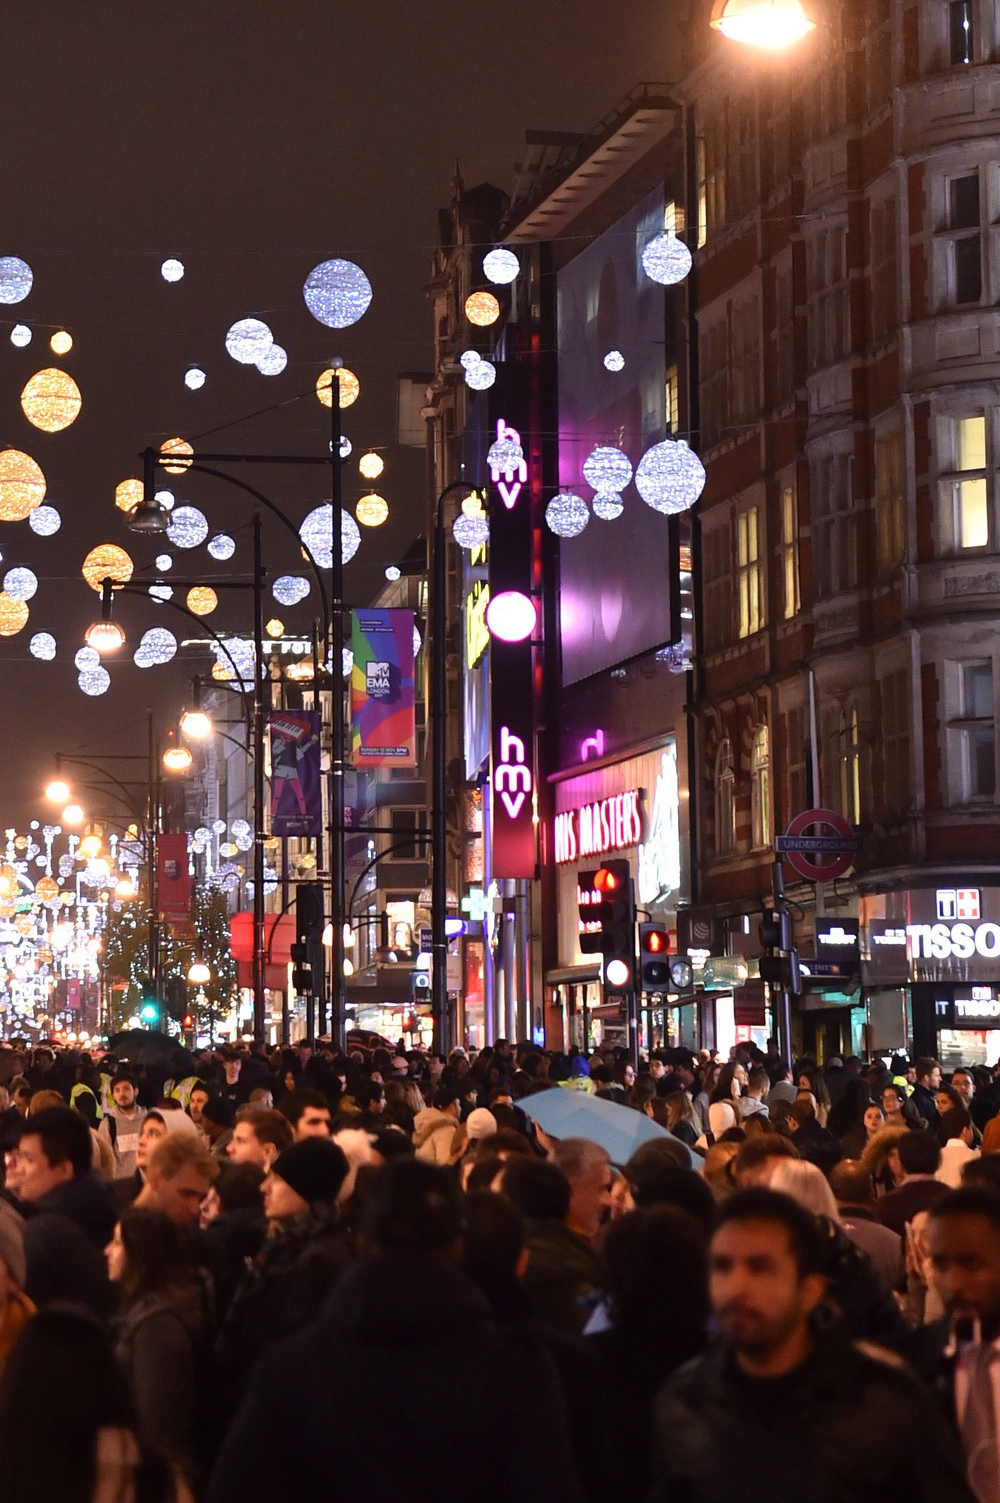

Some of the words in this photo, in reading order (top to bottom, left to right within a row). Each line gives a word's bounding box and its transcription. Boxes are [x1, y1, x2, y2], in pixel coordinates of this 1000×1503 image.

[366, 662, 390, 677] MTV
[366, 678, 390, 688] EMA
[495, 726, 532, 819] hmv
[783, 840, 858, 849] UNDERGROUND
[906, 923, 1000, 959] TISSO
[954, 1000, 1000, 1016] TISSO
